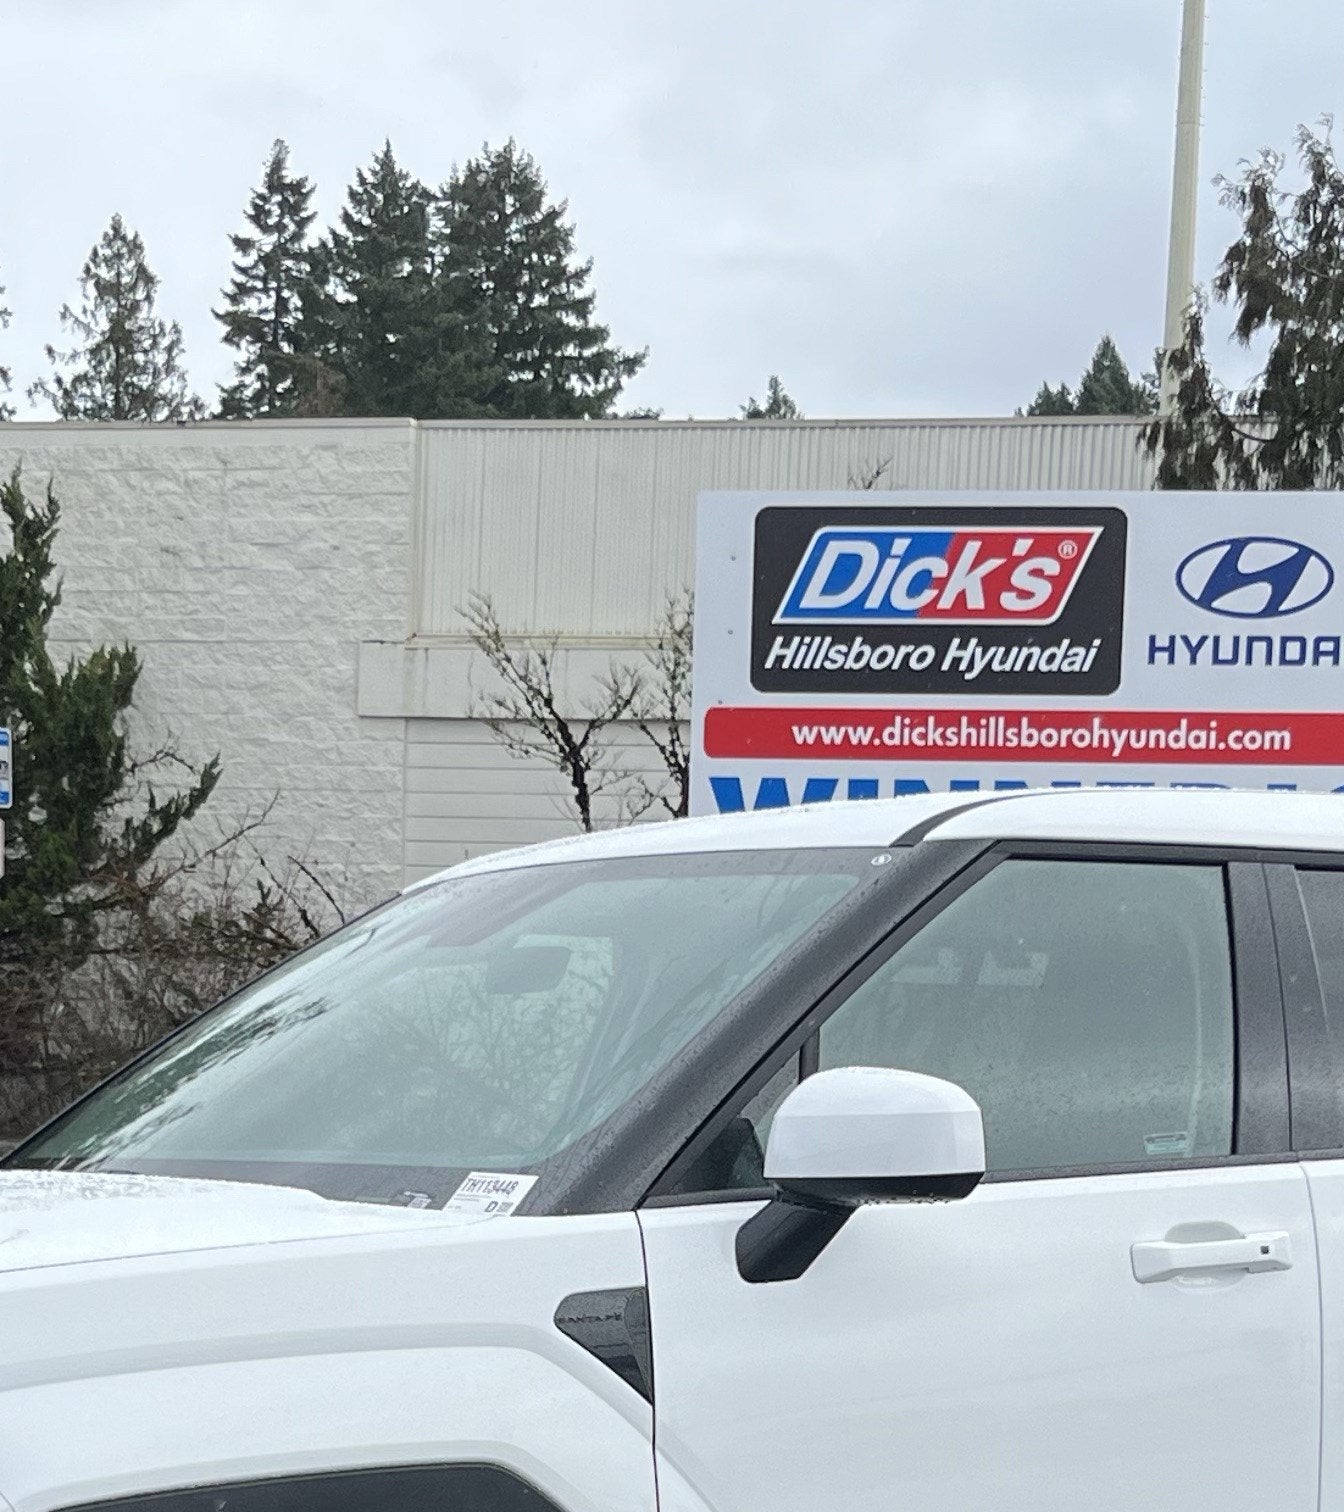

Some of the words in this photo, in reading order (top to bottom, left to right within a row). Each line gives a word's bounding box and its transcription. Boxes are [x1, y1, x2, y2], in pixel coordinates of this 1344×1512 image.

[764, 636, 935, 671] Hillsboro
[941, 638, 1102, 680] Hyundai
[792, 717, 1292, 756] www.dickshillsborohyundai.com
